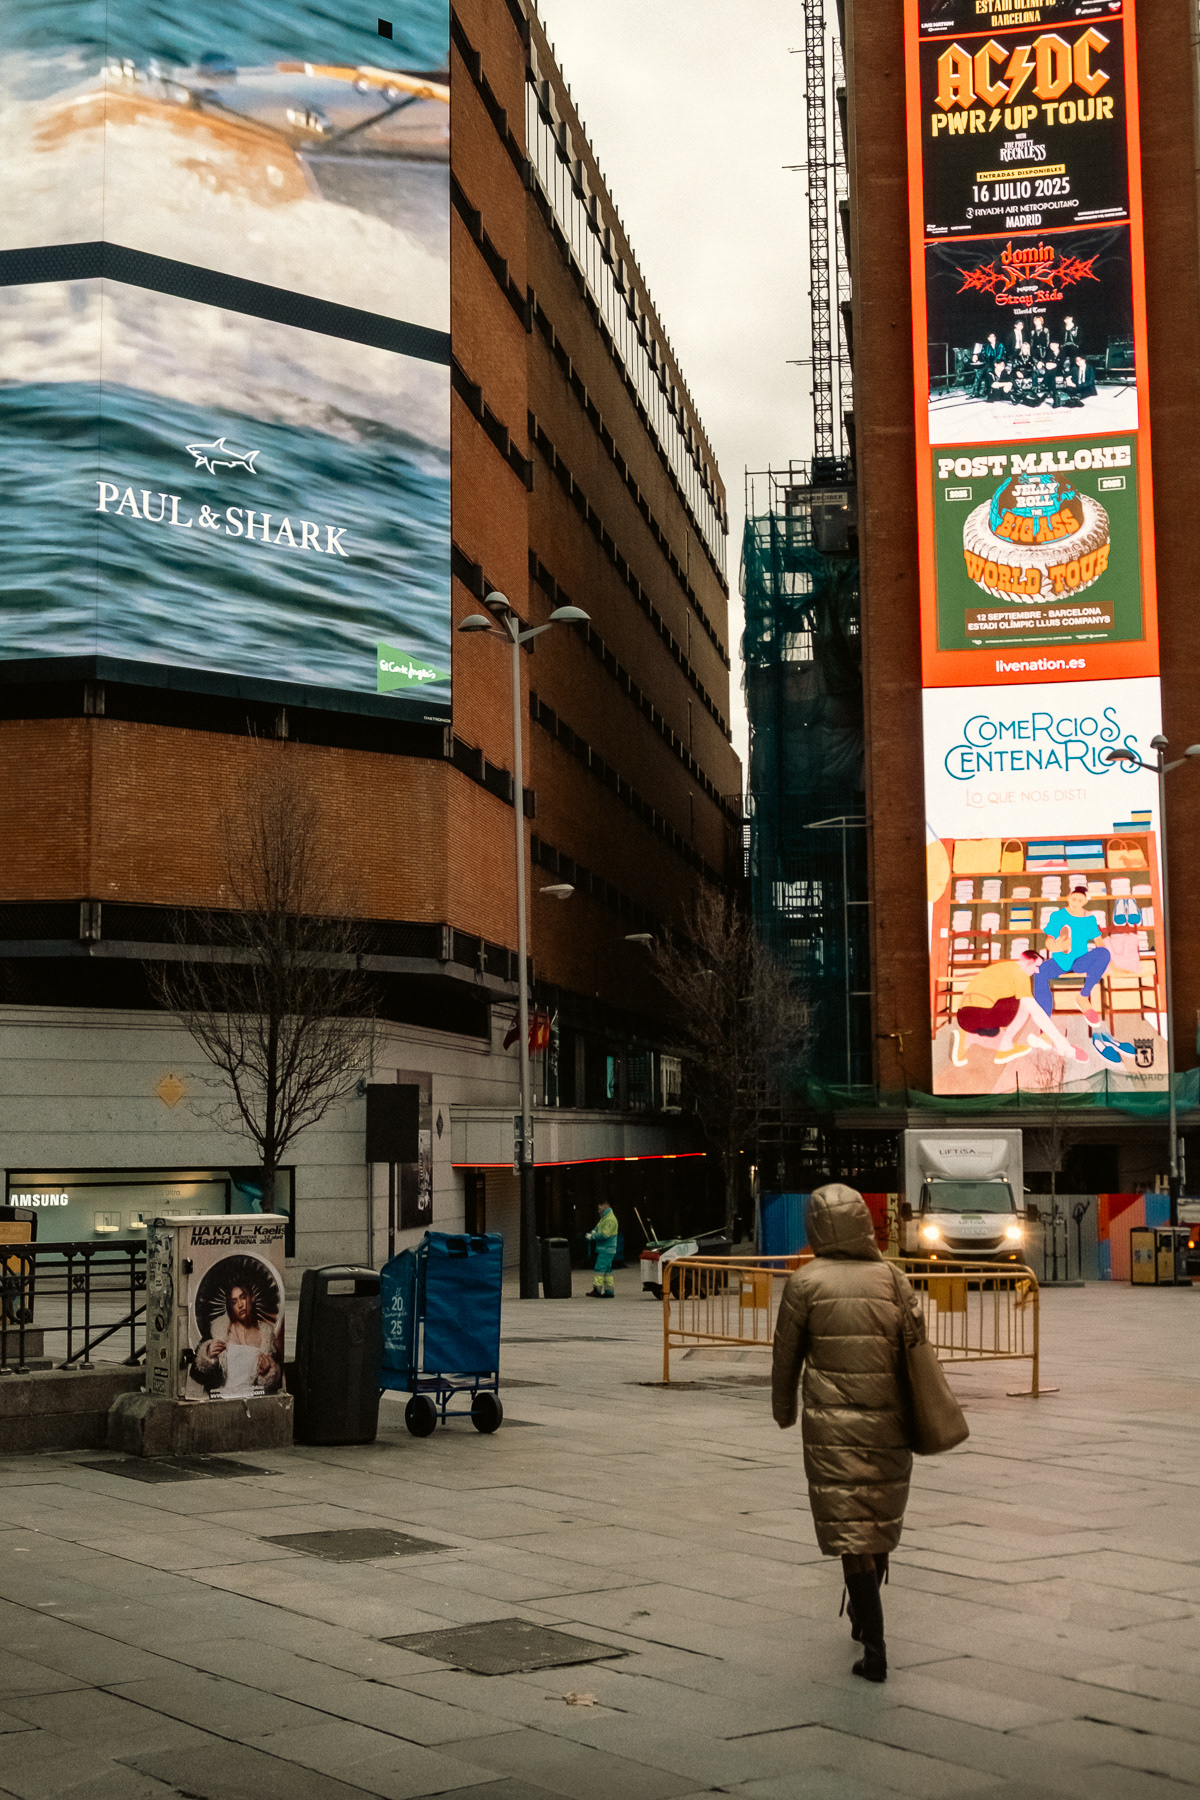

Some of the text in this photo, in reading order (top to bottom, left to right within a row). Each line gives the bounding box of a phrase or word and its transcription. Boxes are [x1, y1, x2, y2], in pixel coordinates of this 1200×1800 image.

[991, 10, 1041, 27] BARCELONA
[1042, 96, 1114, 126] TOUR
[1000, 144, 1047, 162] RECKLESS
[979, 167, 1062, 180] ENTRADAS DISPONIBLES
[972, 177, 1070, 203] 16 JULIO 2025
[975, 207, 1004, 216] RIYADH
[1005, 206, 1019, 214] AIR
[1020, 199, 1079, 212] METROPOLITANO
[1006, 214, 1042, 228] MADRID
[995, 288, 1063, 307] Stray Kids
[938, 445, 1131, 479] POST MALONE
[1012, 483, 1058, 496] JELLY
[1016, 495, 1054, 507] ROLL
[95, 480, 350, 557] PAUL & SHARK
[996, 508, 1080, 542] BIG ASS
[964, 543, 1111, 594] WORLD TOUR
[988, 611, 1042, 621] SEPTIEMBRE
[1048, 607, 1102, 618] BARCELONA
[968, 615, 1110, 630] ESTADI OLÍMPIC LLUIS COMPANYS
[996, 657, 1086, 673] livenation.es
[987, 790, 1017, 805] QUE
[1020, 790, 1050, 803] NOS
[1054, 788, 1087, 802] DISTI
[213, 1226, 242, 1236] KALI
[254, 1225, 285, 1235] Kaelis
[190, 1236, 231, 1245] Madrid
[392, 1296, 403, 1311] 20
[391, 1320, 402, 1335] 25
